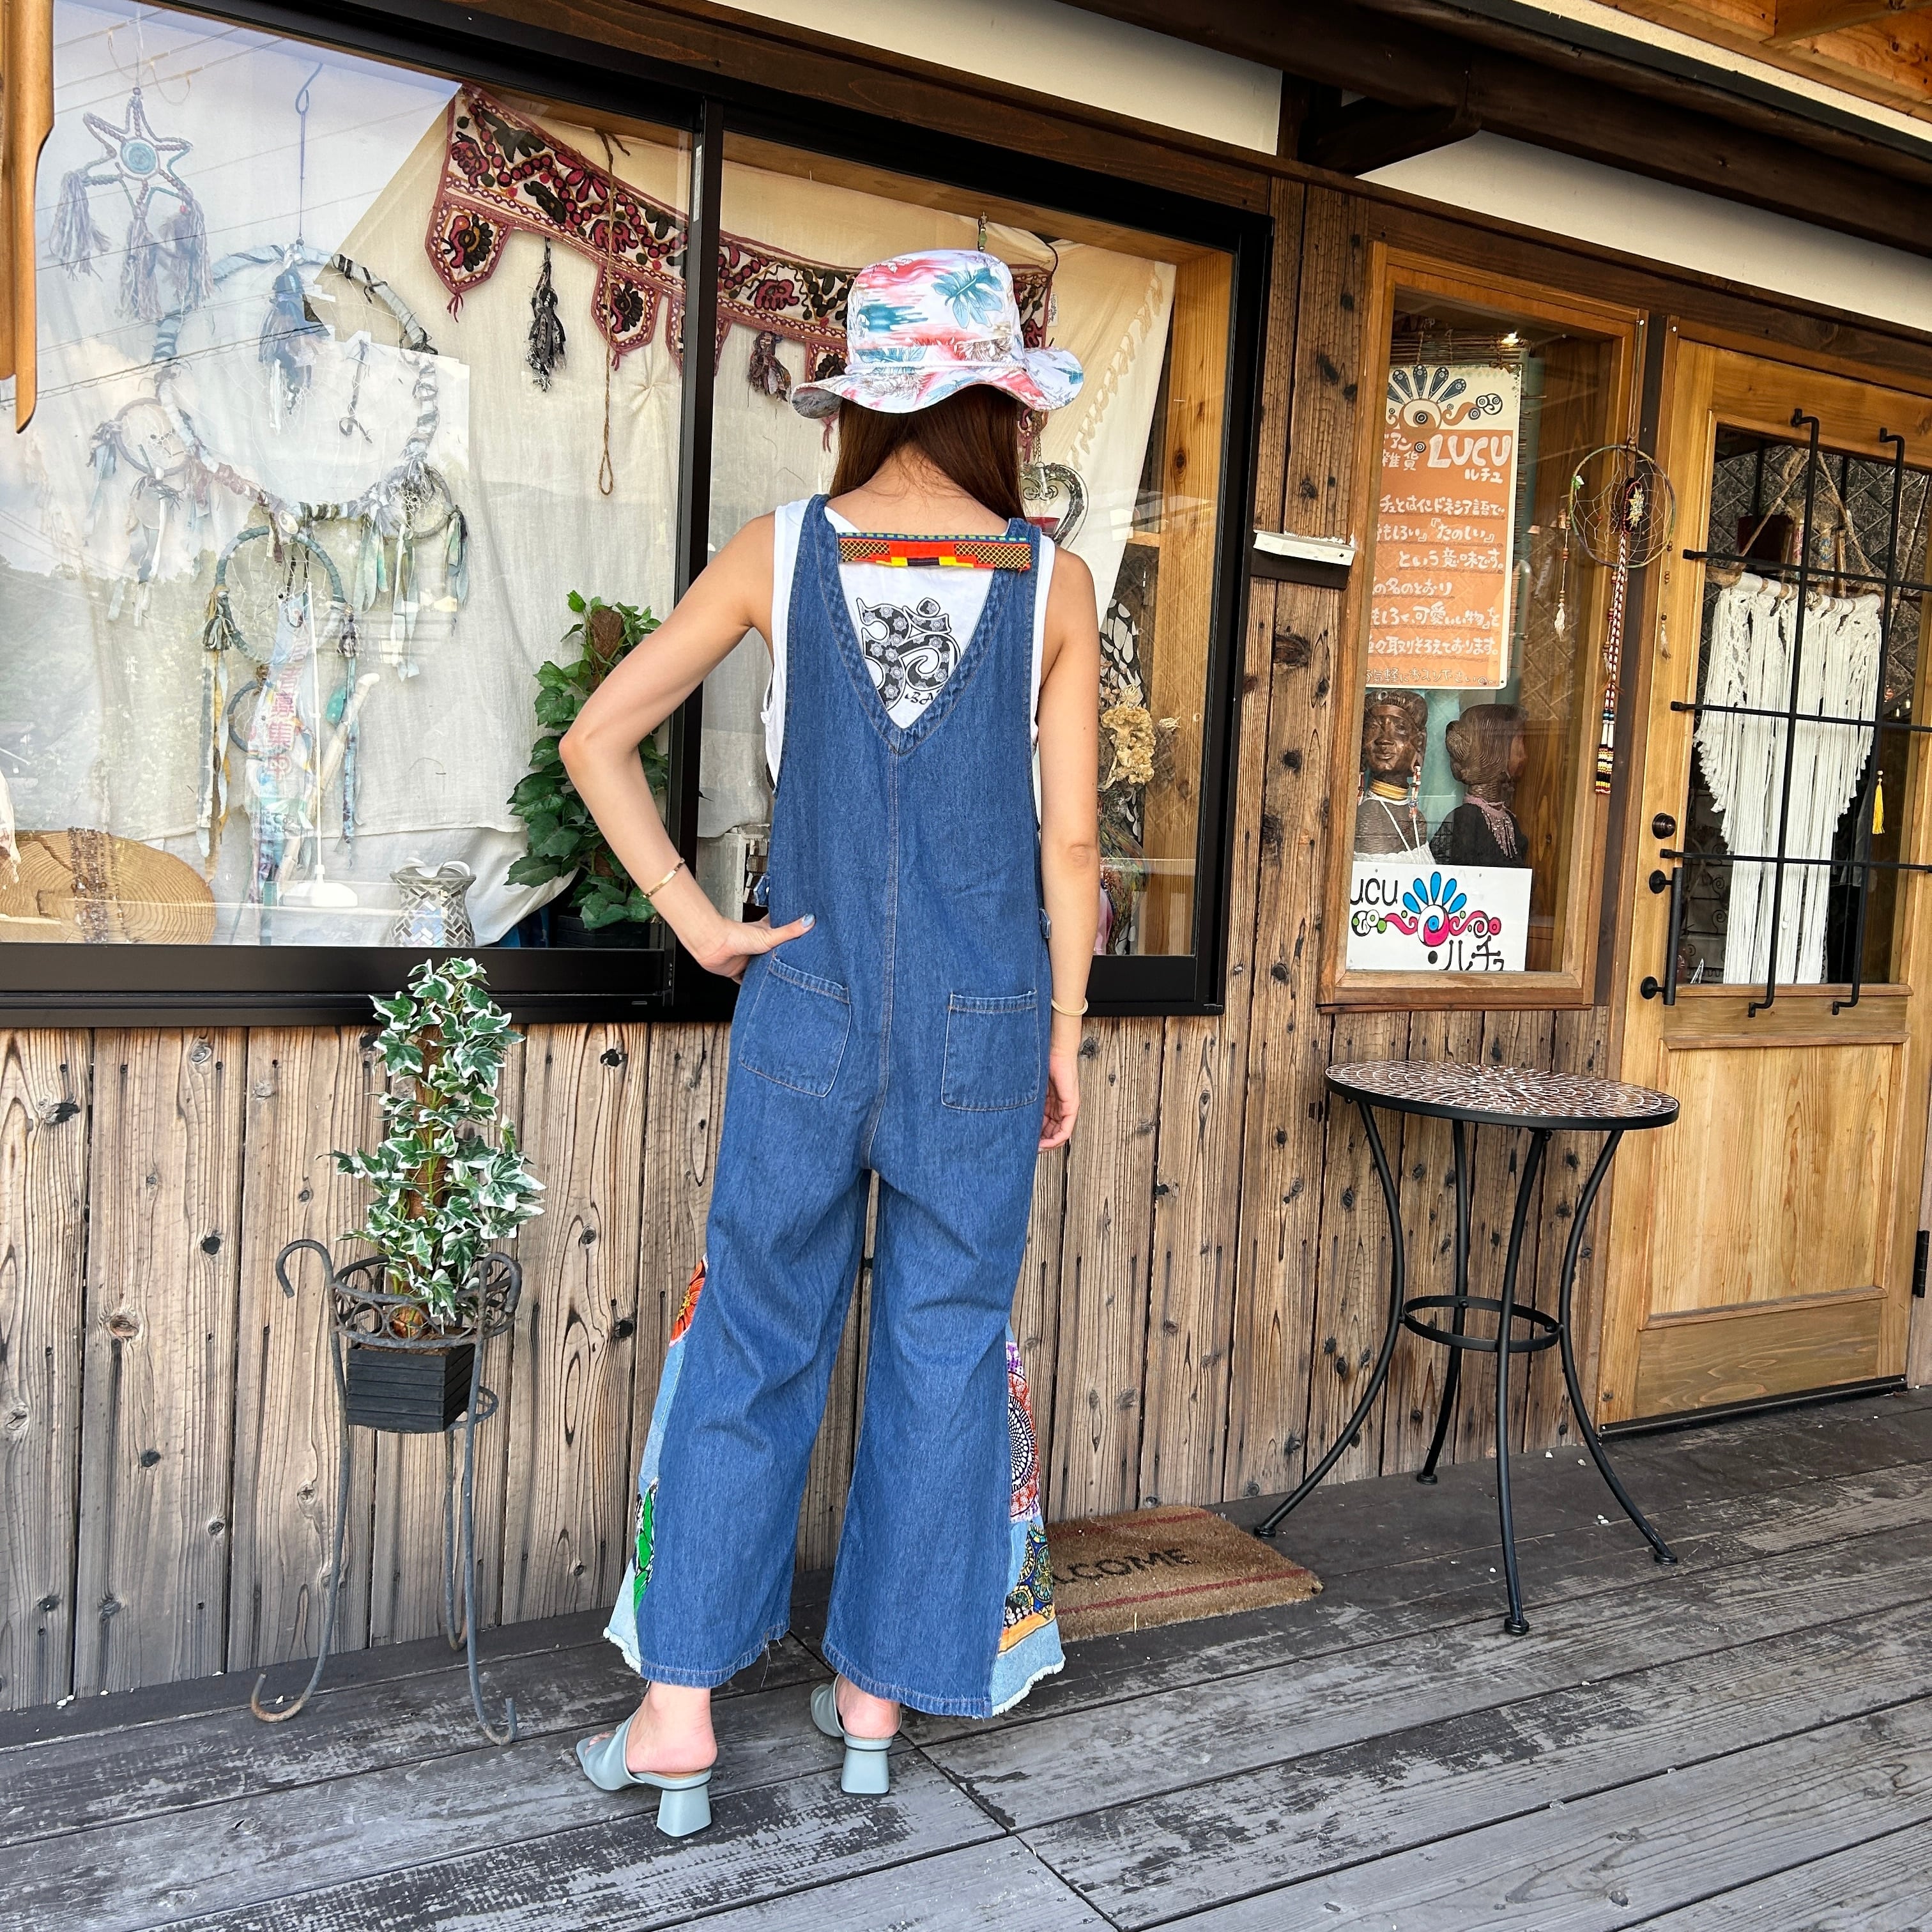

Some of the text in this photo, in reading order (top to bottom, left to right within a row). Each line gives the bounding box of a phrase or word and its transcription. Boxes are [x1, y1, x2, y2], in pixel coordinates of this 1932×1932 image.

[1384, 432, 1412, 450] アン
[1427, 434, 1512, 468] LUCU
[1383, 450, 1420, 471] 雑貨
[1464, 468, 1503, 484] ルチュ
[1399, 547, 1504, 569] という意味です。
[1372, 576, 1452, 595] の名のとおり
